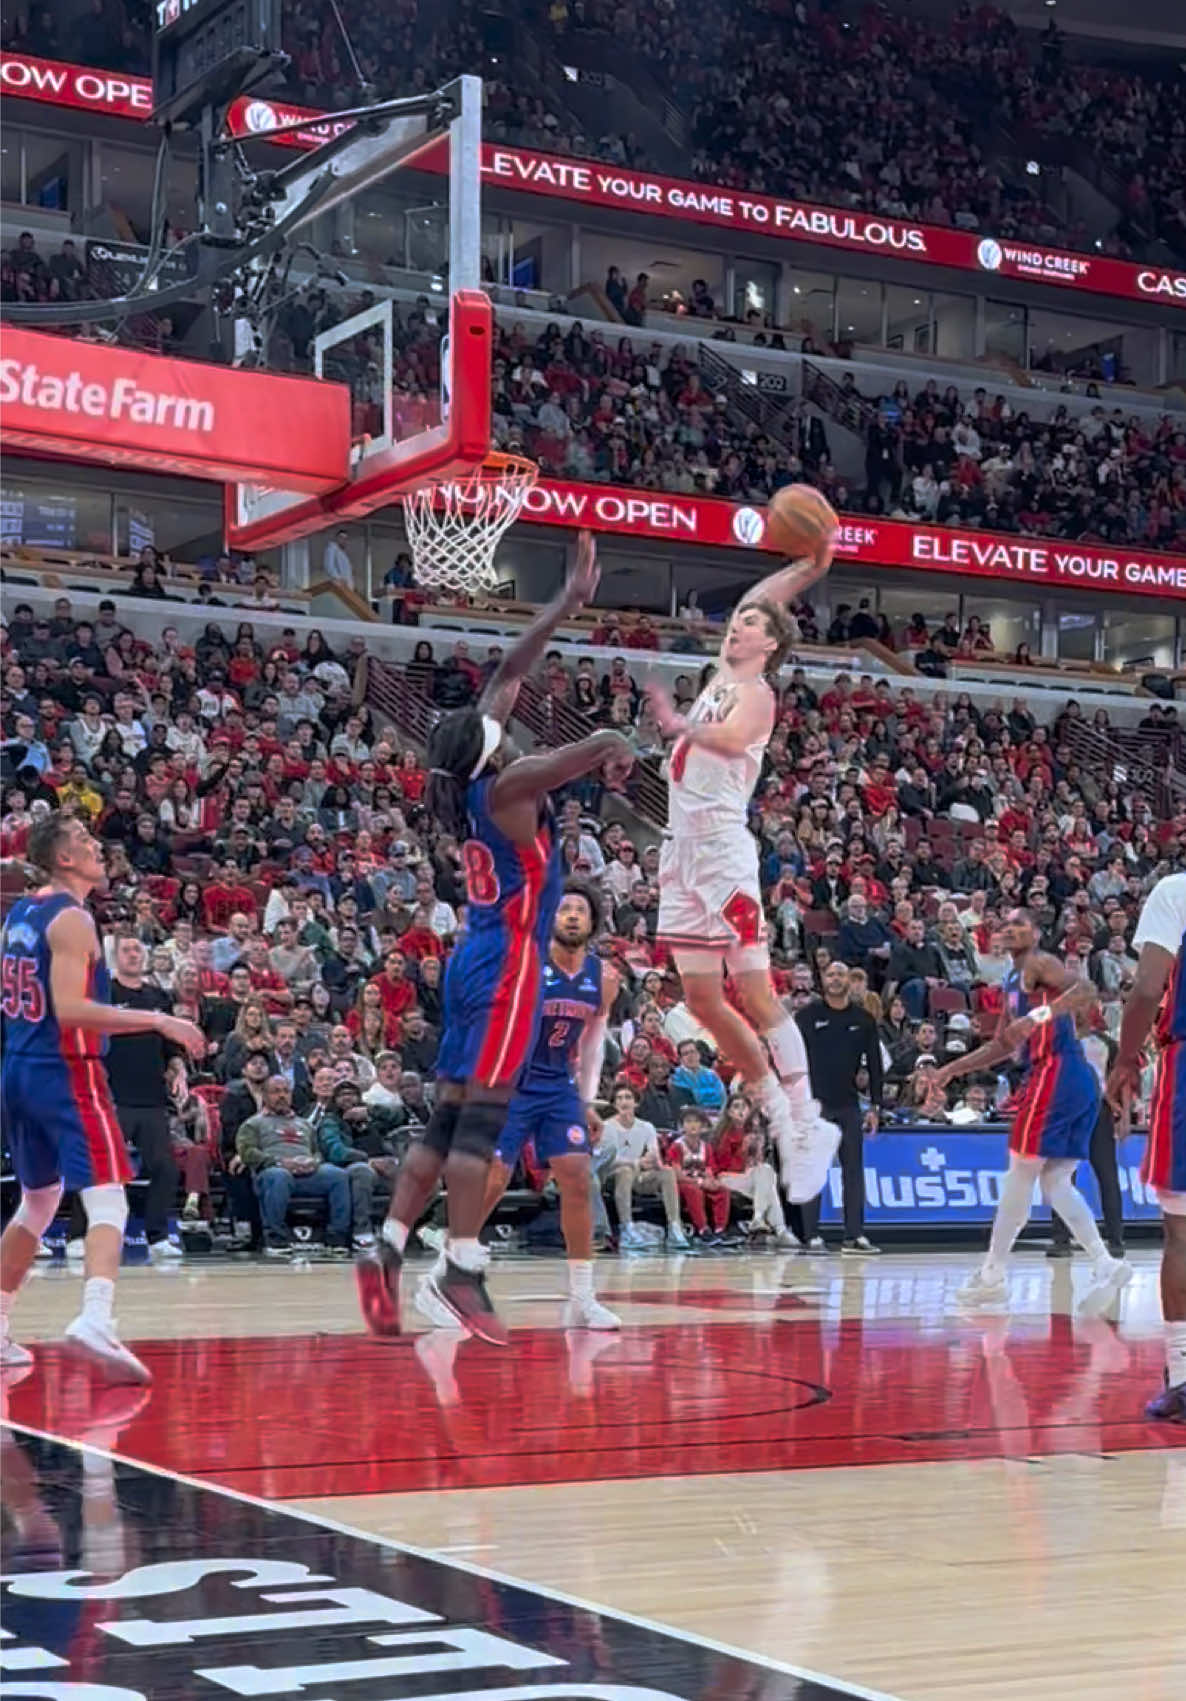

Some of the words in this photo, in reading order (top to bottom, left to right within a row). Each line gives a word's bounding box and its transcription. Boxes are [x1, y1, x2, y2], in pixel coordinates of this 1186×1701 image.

[597, 174, 662, 202] YOUR
[667, 189, 734, 217] GAME
[739, 201, 769, 222] TO
[1003, 247, 1043, 265] WIND
[1044, 254, 1088, 275] CREEK
[1137, 272, 1186, 298] CAS
[495, 485, 588, 517] NOW
[596, 497, 697, 532] OPEN
[836, 525, 875, 545] REEK
[912, 535, 1049, 572] ELEVATE
[1055, 553, 1118, 580] YOUR
[1124, 563, 1186, 588] GAME
[0, 953, 46, 1023] 55
[547, 1020, 571, 1048] 2
